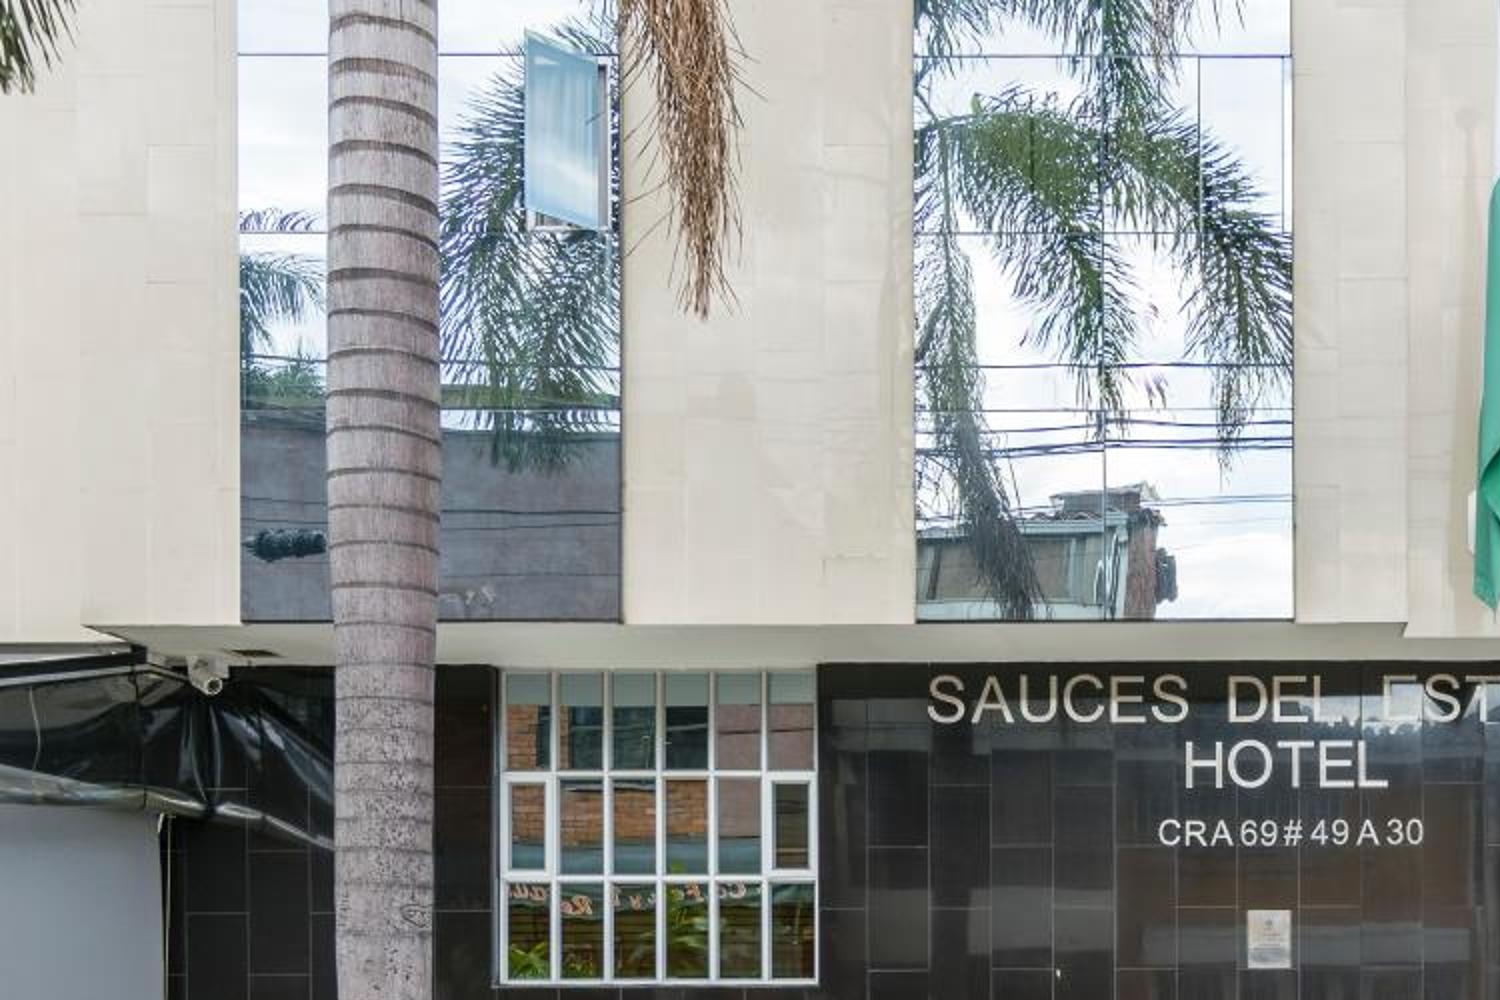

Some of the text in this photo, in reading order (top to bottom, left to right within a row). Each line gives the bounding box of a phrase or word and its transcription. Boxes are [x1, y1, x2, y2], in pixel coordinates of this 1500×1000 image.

[926, 675, 1189, 724] SAUCES
[1227, 675, 1344, 723] DEL
[1185, 739, 1389, 788] HOTEL
[1158, 818, 1234, 847] CRA
[1386, 818, 1424, 846] 30
